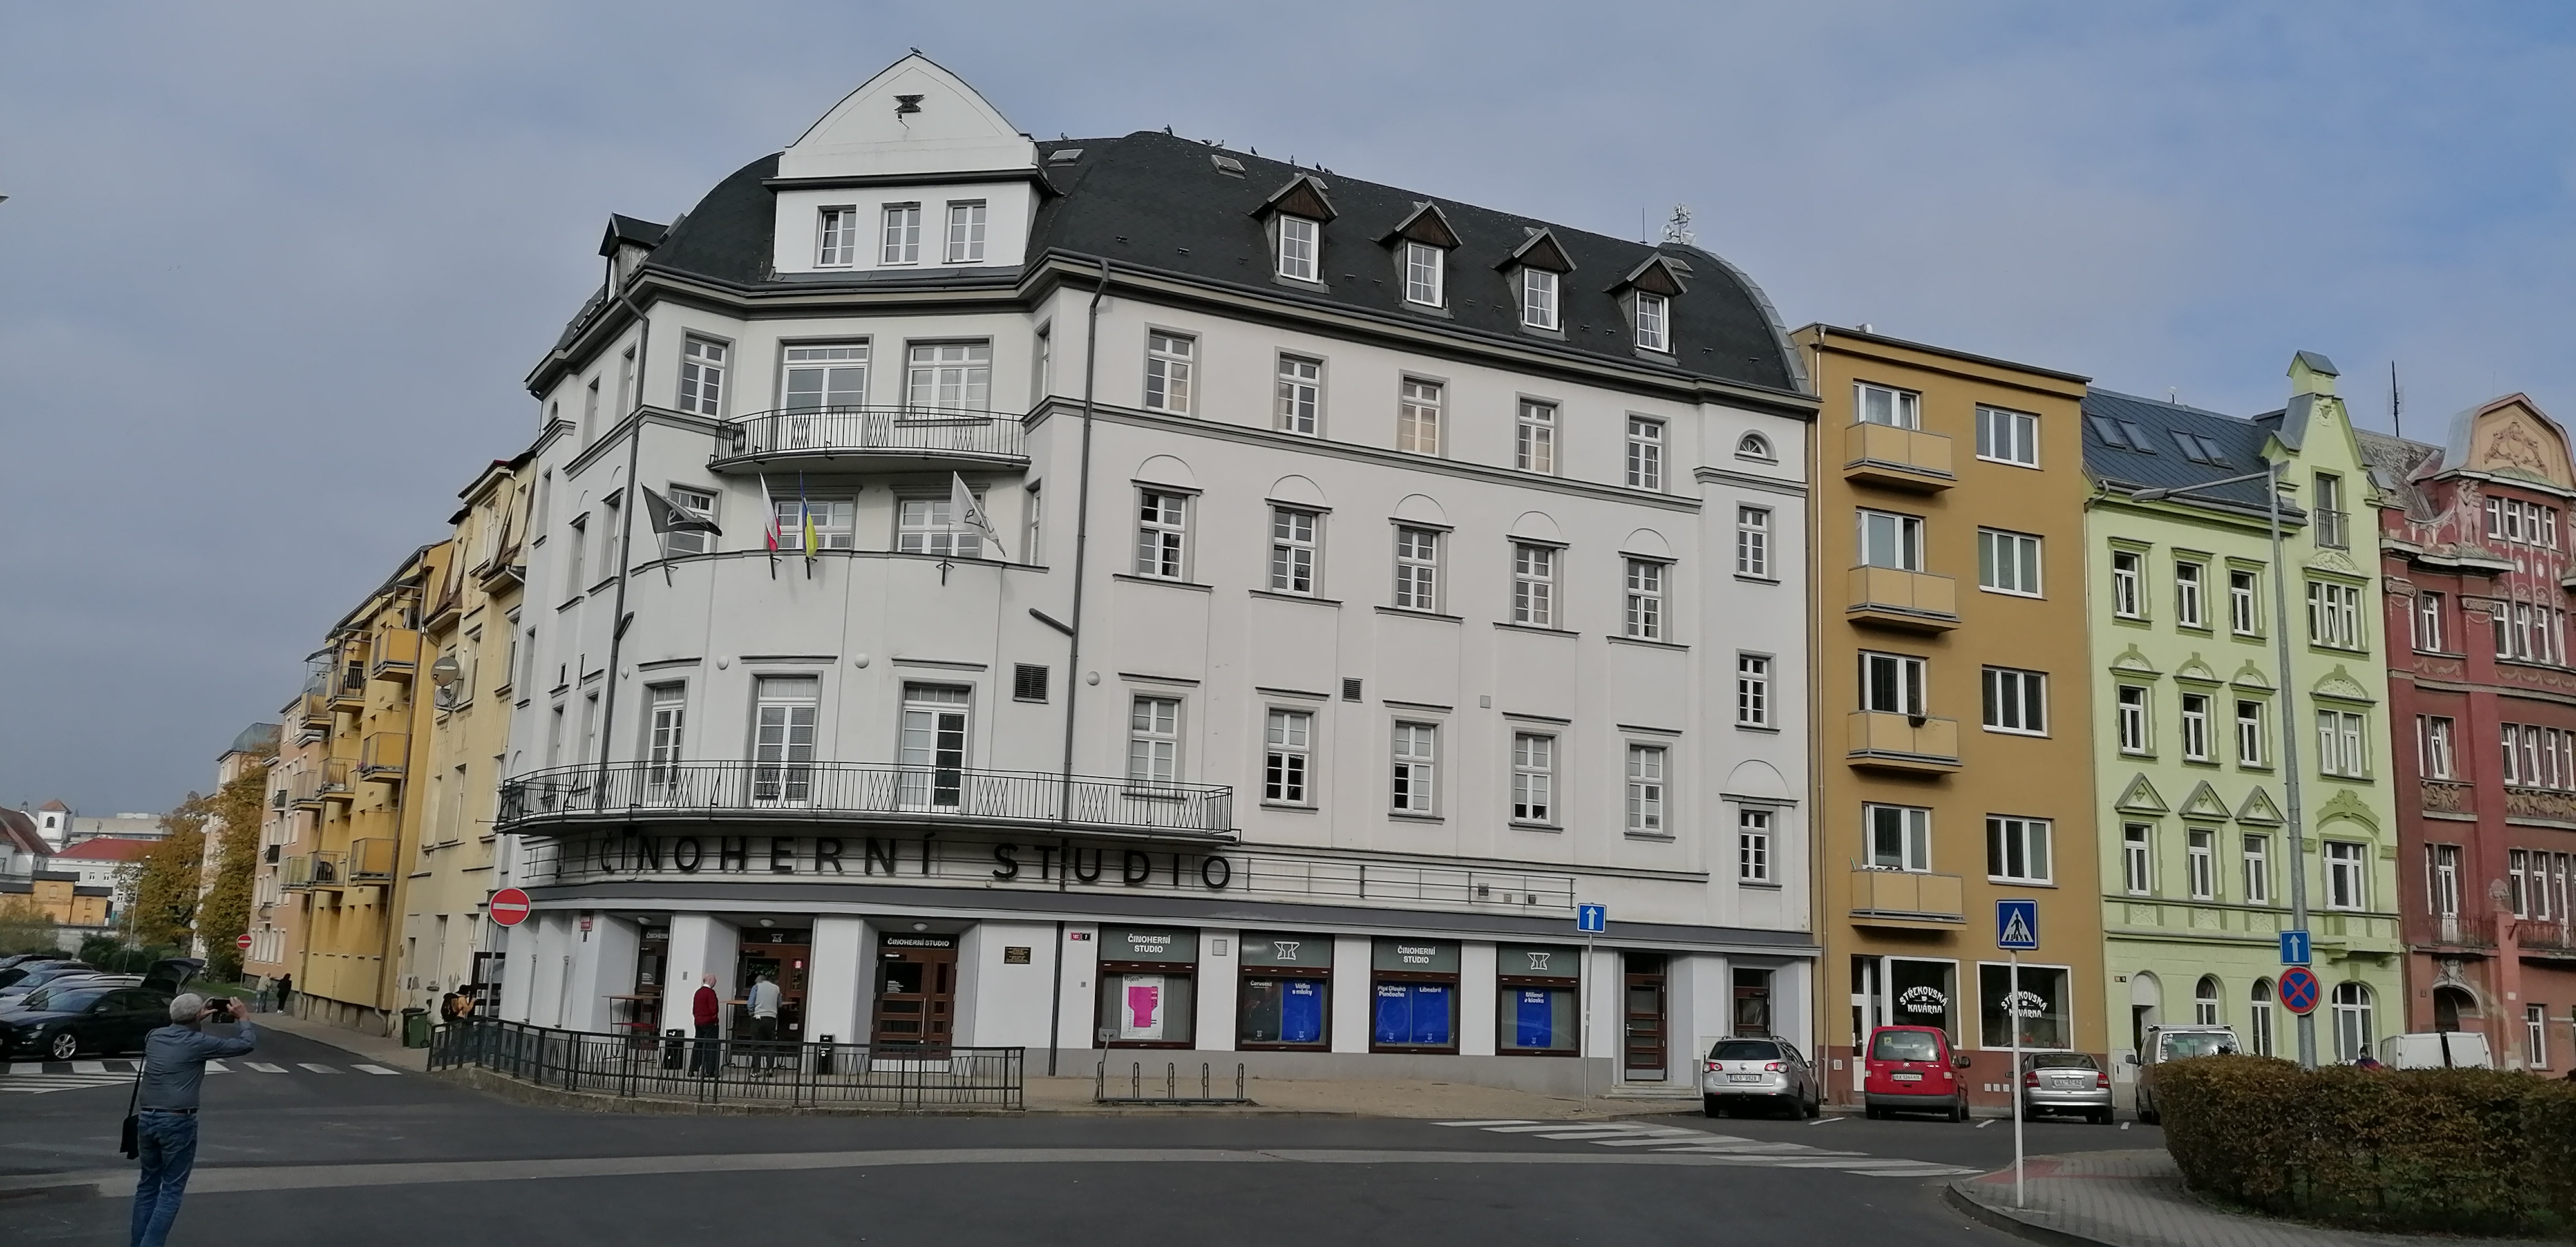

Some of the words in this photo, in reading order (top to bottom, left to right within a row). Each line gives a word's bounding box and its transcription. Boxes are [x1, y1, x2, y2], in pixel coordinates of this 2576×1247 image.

[600, 828, 936, 875] ČINOHERNÍ
[992, 842, 1231, 889] STUDIO
[887, 937, 924, 946] ČINOHERNÍ
[1127, 933, 1171, 944] ČINOHERNÍ
[1134, 945, 1164, 953] STUDIO
[1397, 945, 1436, 955] ČINOHERNÍ
[1899, 985, 1949, 1007] STŘEKOVSKÁ
[1907, 1002, 1942, 1014] KAVÁRNA
[2009, 1007, 2042, 1018] KVÁRNA
